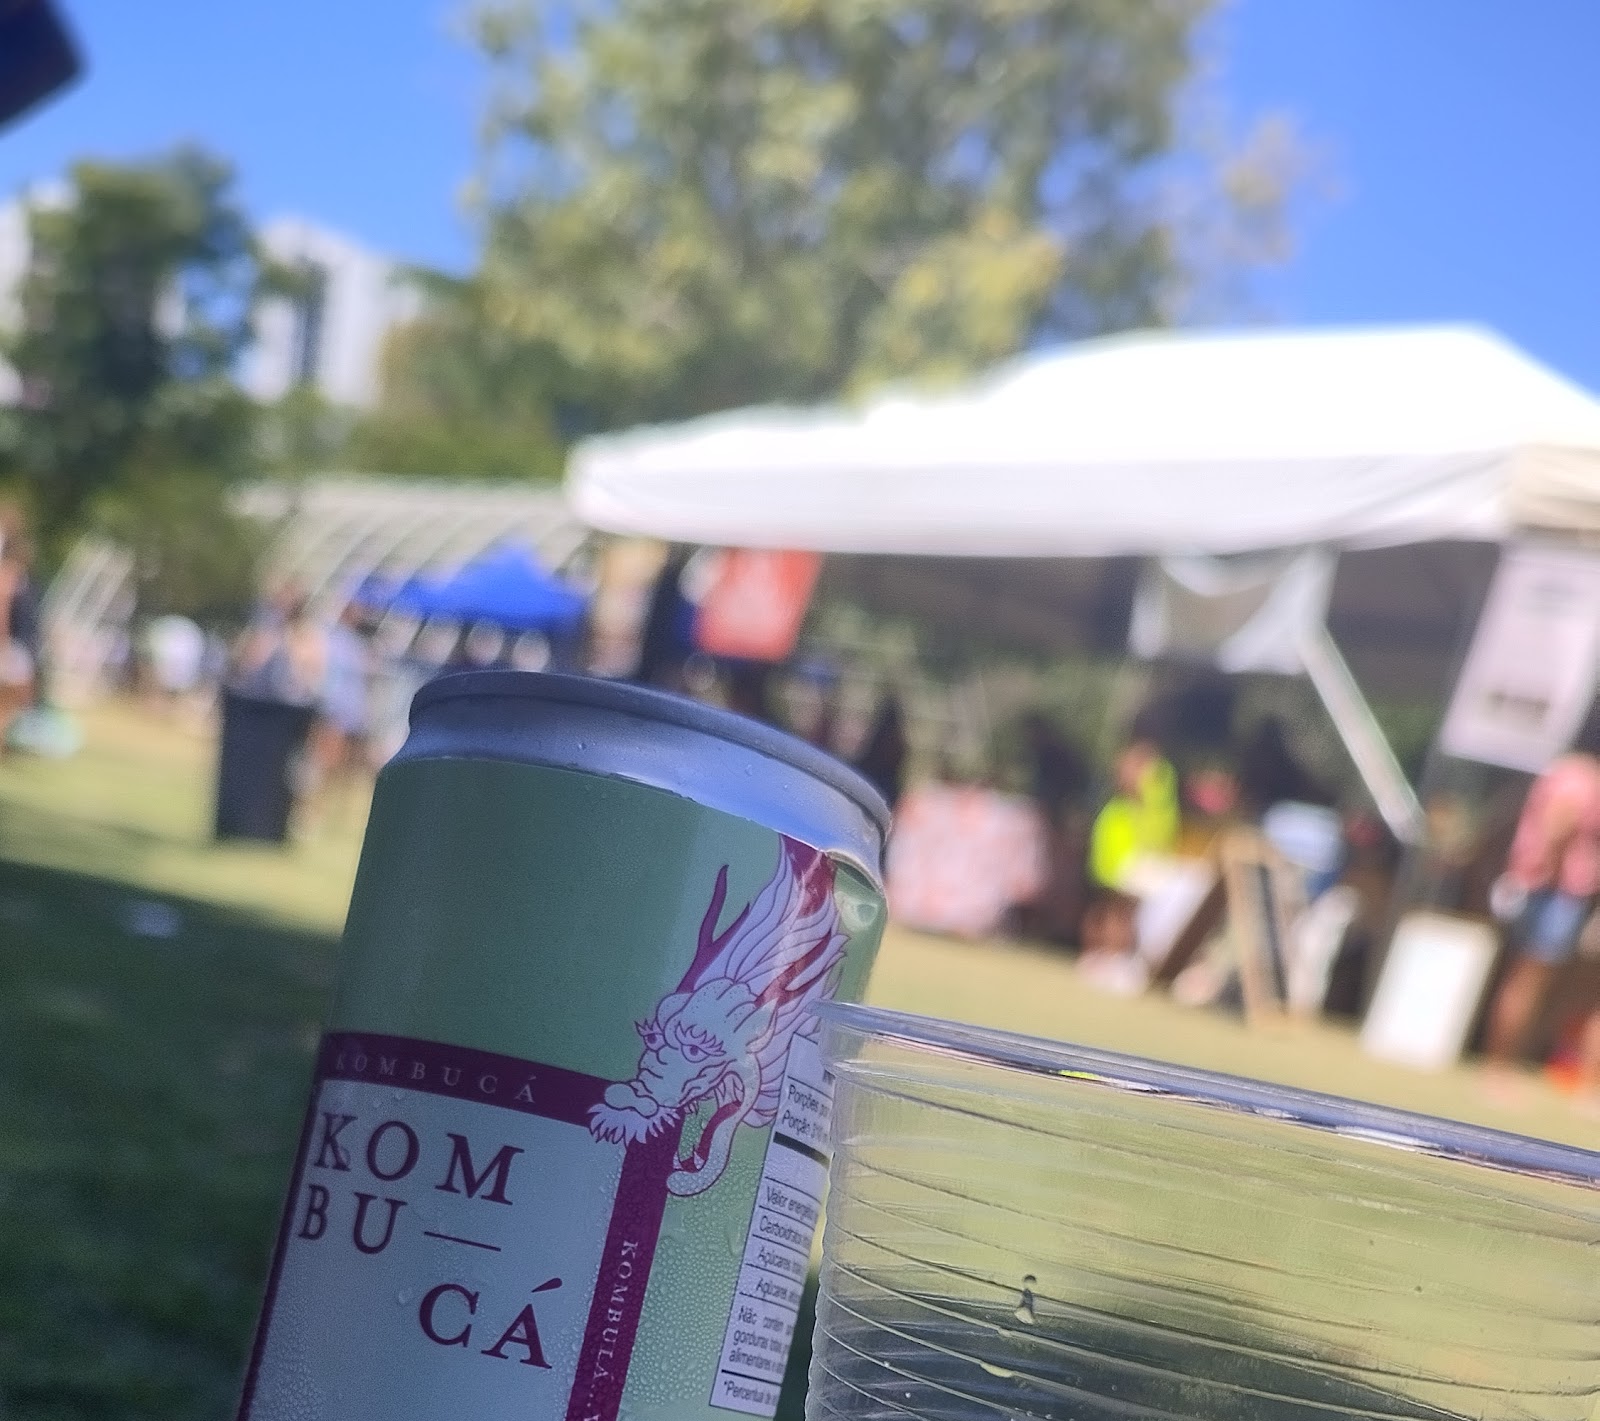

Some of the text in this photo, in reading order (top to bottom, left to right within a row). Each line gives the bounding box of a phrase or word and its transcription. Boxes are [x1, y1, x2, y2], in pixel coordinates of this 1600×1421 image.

[334, 1054, 537, 1103] KOMBUCÁ
[314, 1111, 525, 1206] KOM
[298, 1183, 407, 1254] BU
[419, 1277, 562, 1369] CÁ
